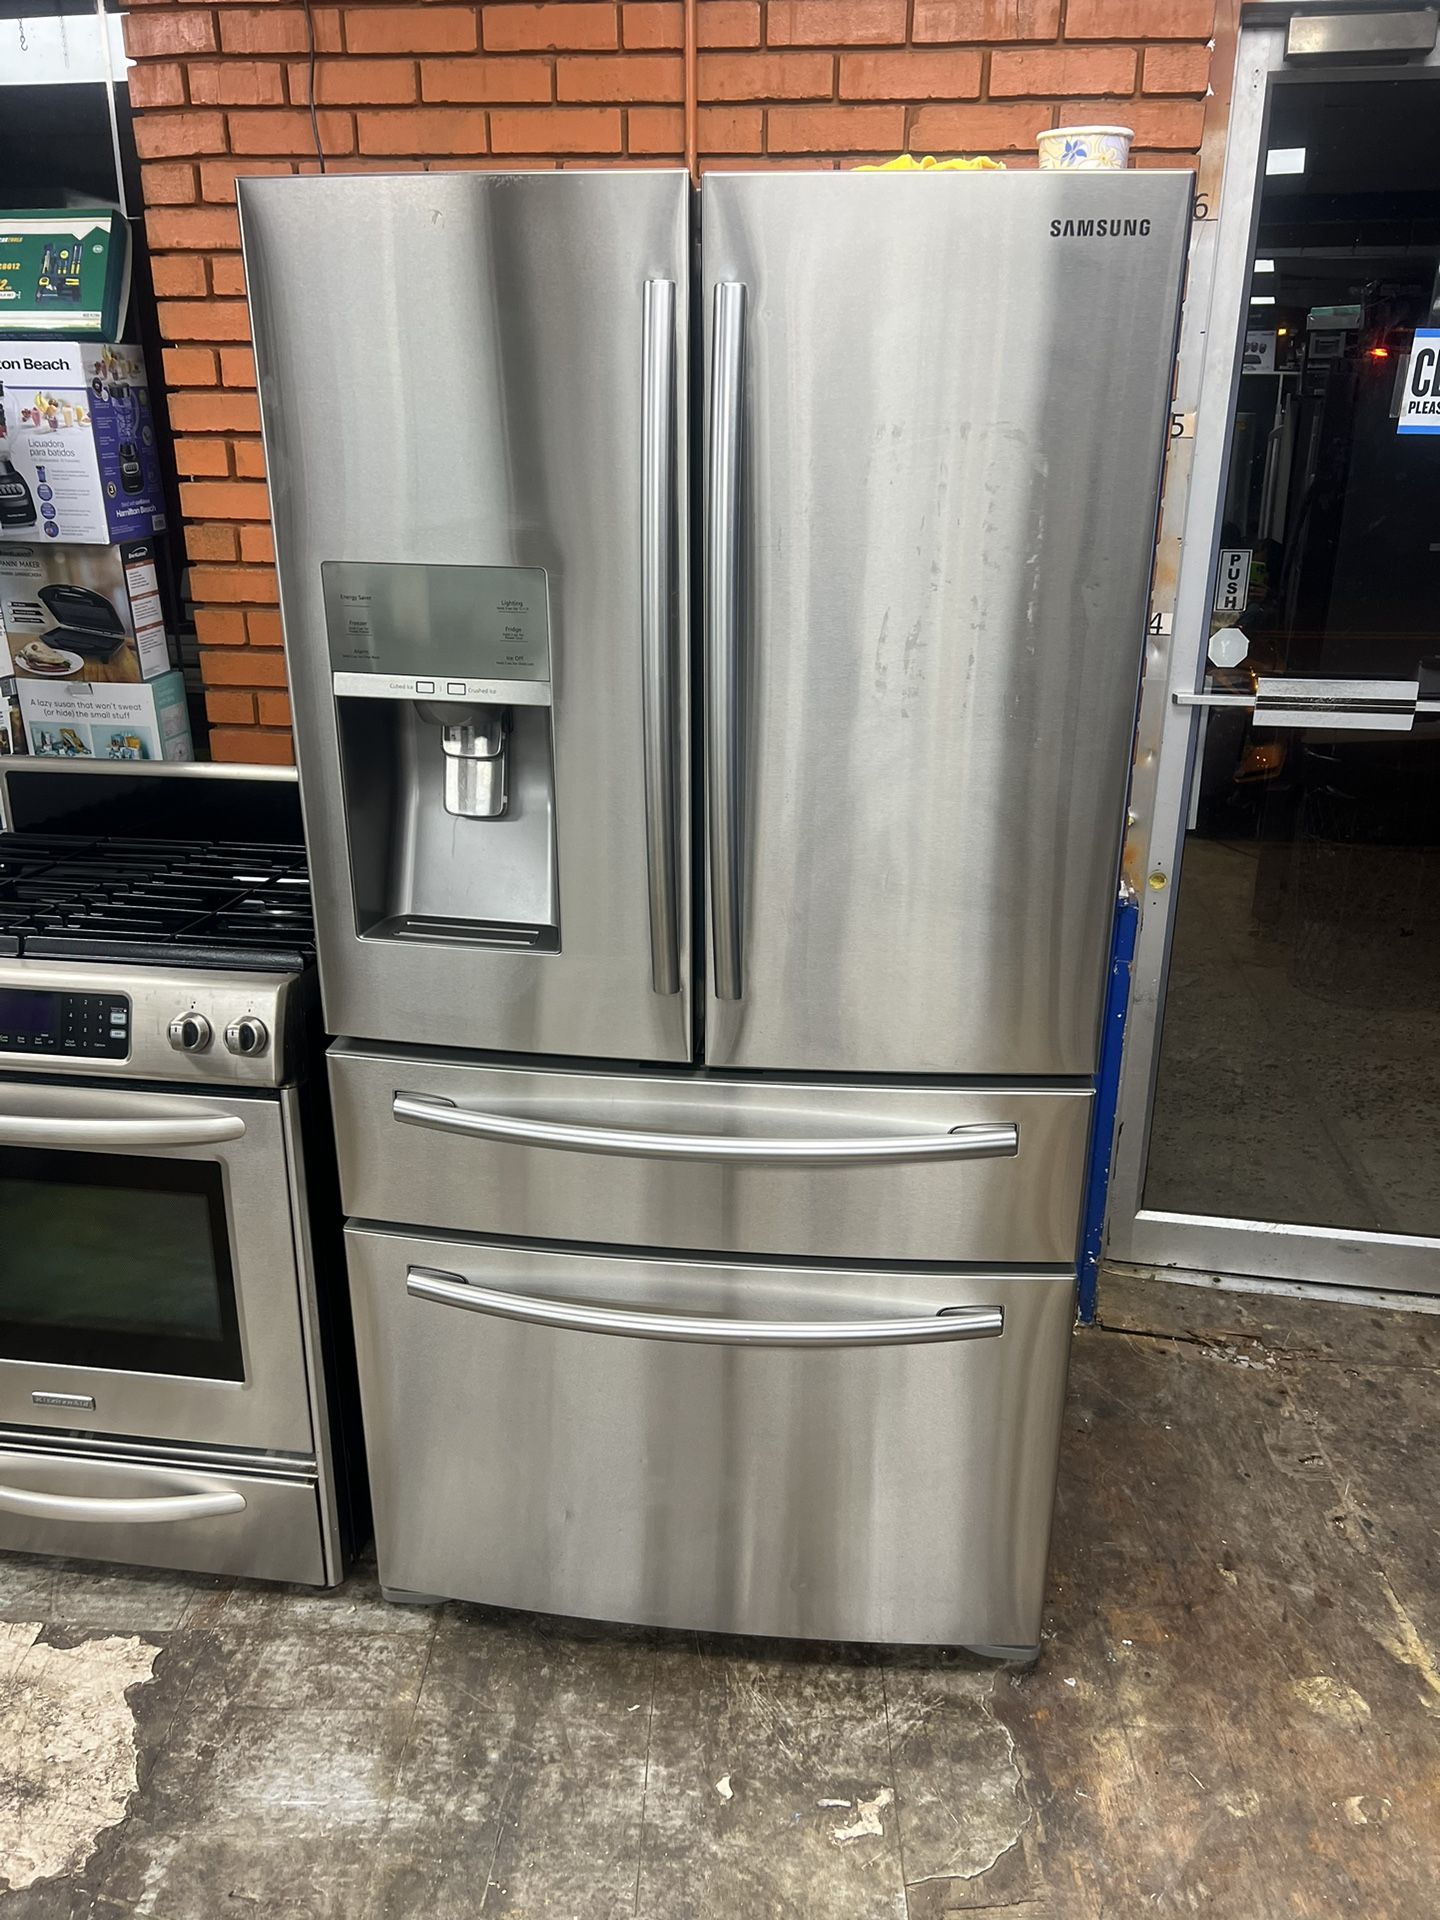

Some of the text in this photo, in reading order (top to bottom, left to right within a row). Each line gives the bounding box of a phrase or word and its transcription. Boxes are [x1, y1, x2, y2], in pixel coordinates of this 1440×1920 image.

[1193, 193, 1208, 219] 6
[1050, 219, 1151, 237] SAMSUNG
[23, 358, 70, 370] Beach
[1171, 413, 1184, 437] 5
[28, 439, 64, 448] Licuadora
[30, 448, 76, 457] para batidos
[116, 507, 140, 518] Hamilton
[19, 560, 40, 569] MAKER
[1224, 554, 1241, 610] PUSH
[1150, 612, 1163, 635] 4
[37, 699, 52, 708] lazy
[77, 701, 94, 709] that
[95, 702, 117, 710] won't
[118, 703, 142, 712] sweat
[43, 709, 55, 717] (or
[56, 708, 75, 718] hide)
[76, 710, 89, 718] the
[90, 711, 111, 719] small
